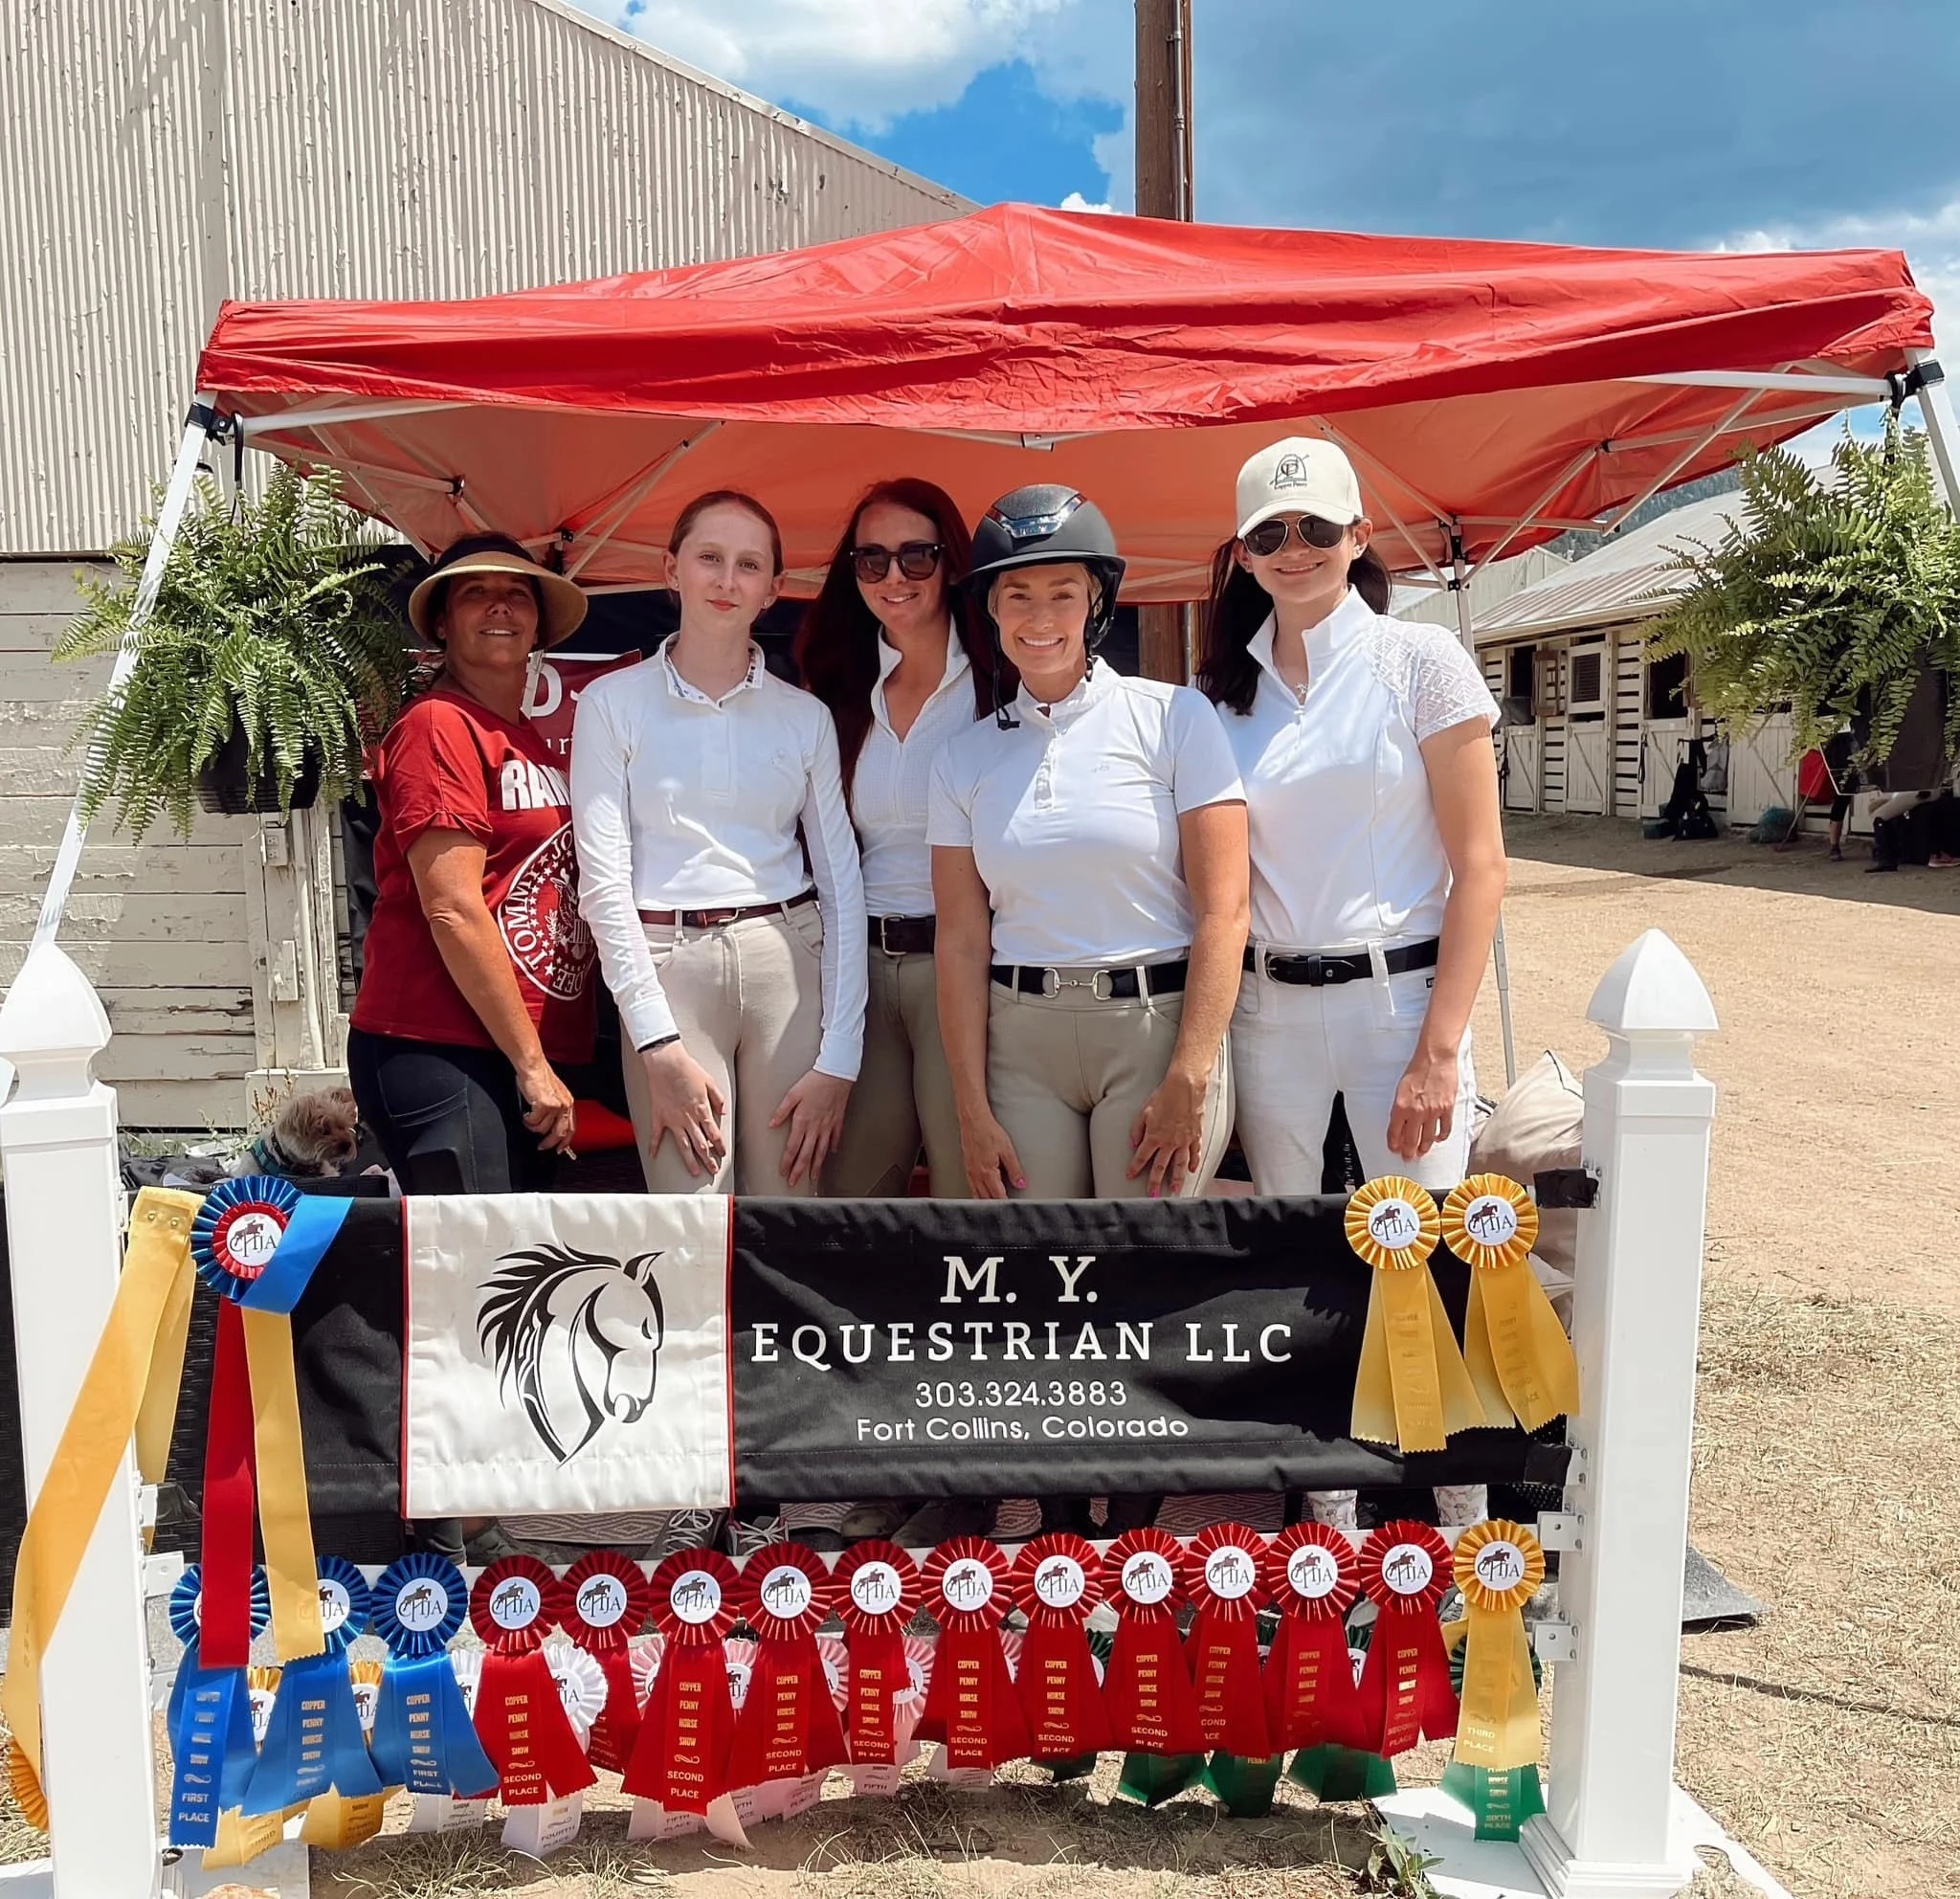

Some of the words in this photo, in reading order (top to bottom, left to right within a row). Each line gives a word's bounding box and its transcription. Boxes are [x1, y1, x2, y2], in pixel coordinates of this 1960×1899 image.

[505, 863, 548, 972] TOMMY
[940, 1256, 1017, 1303] M.
[1049, 1256, 1098, 1303] Y.
[751, 1322, 1154, 1372] EQUESTRIAN
[1185, 1323, 1292, 1363] LLC
[915, 1380, 1127, 1408] 303.324.3883
[857, 1418, 916, 1441] Fort
[925, 1417, 1031, 1441] Collins,
[1041, 1415, 1189, 1439] Colorado
[1209, 1646, 1231, 1655] COPPER
[1397, 1648, 1418, 1659] COPPER
[957, 1661, 980, 1669] COPPER
[1044, 1661, 1067, 1669] COPPER
[1399, 1664, 1416, 1675] PENNY
[859, 1669, 881, 1680] COPPER
[776, 1675, 798, 1686] COPPER
[959, 1677, 978, 1686] PENNY
[1046, 1676, 1065, 1685] PENNY
[679, 1682, 702, 1692] COPPER
[777, 1692, 796, 1701] PENNY
[860, 1687, 880, 1698] PENNY
[406, 1694, 430, 1706] COPPER
[505, 1695, 528, 1706] COPPER
[959, 1693, 978, 1703] HORSE
[301, 1700, 326, 1710] COPPER
[679, 1700, 699, 1710] PENNY
[777, 1708, 795, 1716] HORSE
[960, 1710, 977, 1719] SHOW
[409, 1712, 429, 1723] PENNY
[508, 1713, 527, 1724] PENNY
[679, 1718, 698, 1729] HORSE
[777, 1723, 794, 1731] SHOW
[1131, 1727, 1168, 1737] SECOND
[1467, 1727, 1495, 1739] THIRD
[679, 1736, 696, 1747] SHOW
[1038, 1734, 1075, 1743] SECOND
[854, 1740, 890, 1749] SECOND
[1463, 1739, 1495, 1754] PLACE
[511, 1746, 528, 1755] SHOW
[766, 1749, 802, 1759] SECOND
[768, 1763, 796, 1773] PLACE
[503, 1773, 542, 1783] SECOND
[667, 1771, 703, 1782] SECOND
[508, 1787, 539, 1796] PLACE
[671, 1787, 700, 1799] PLACE
[182, 1793, 209, 1803] FIRST
[178, 1812, 210, 1822] PLACE
